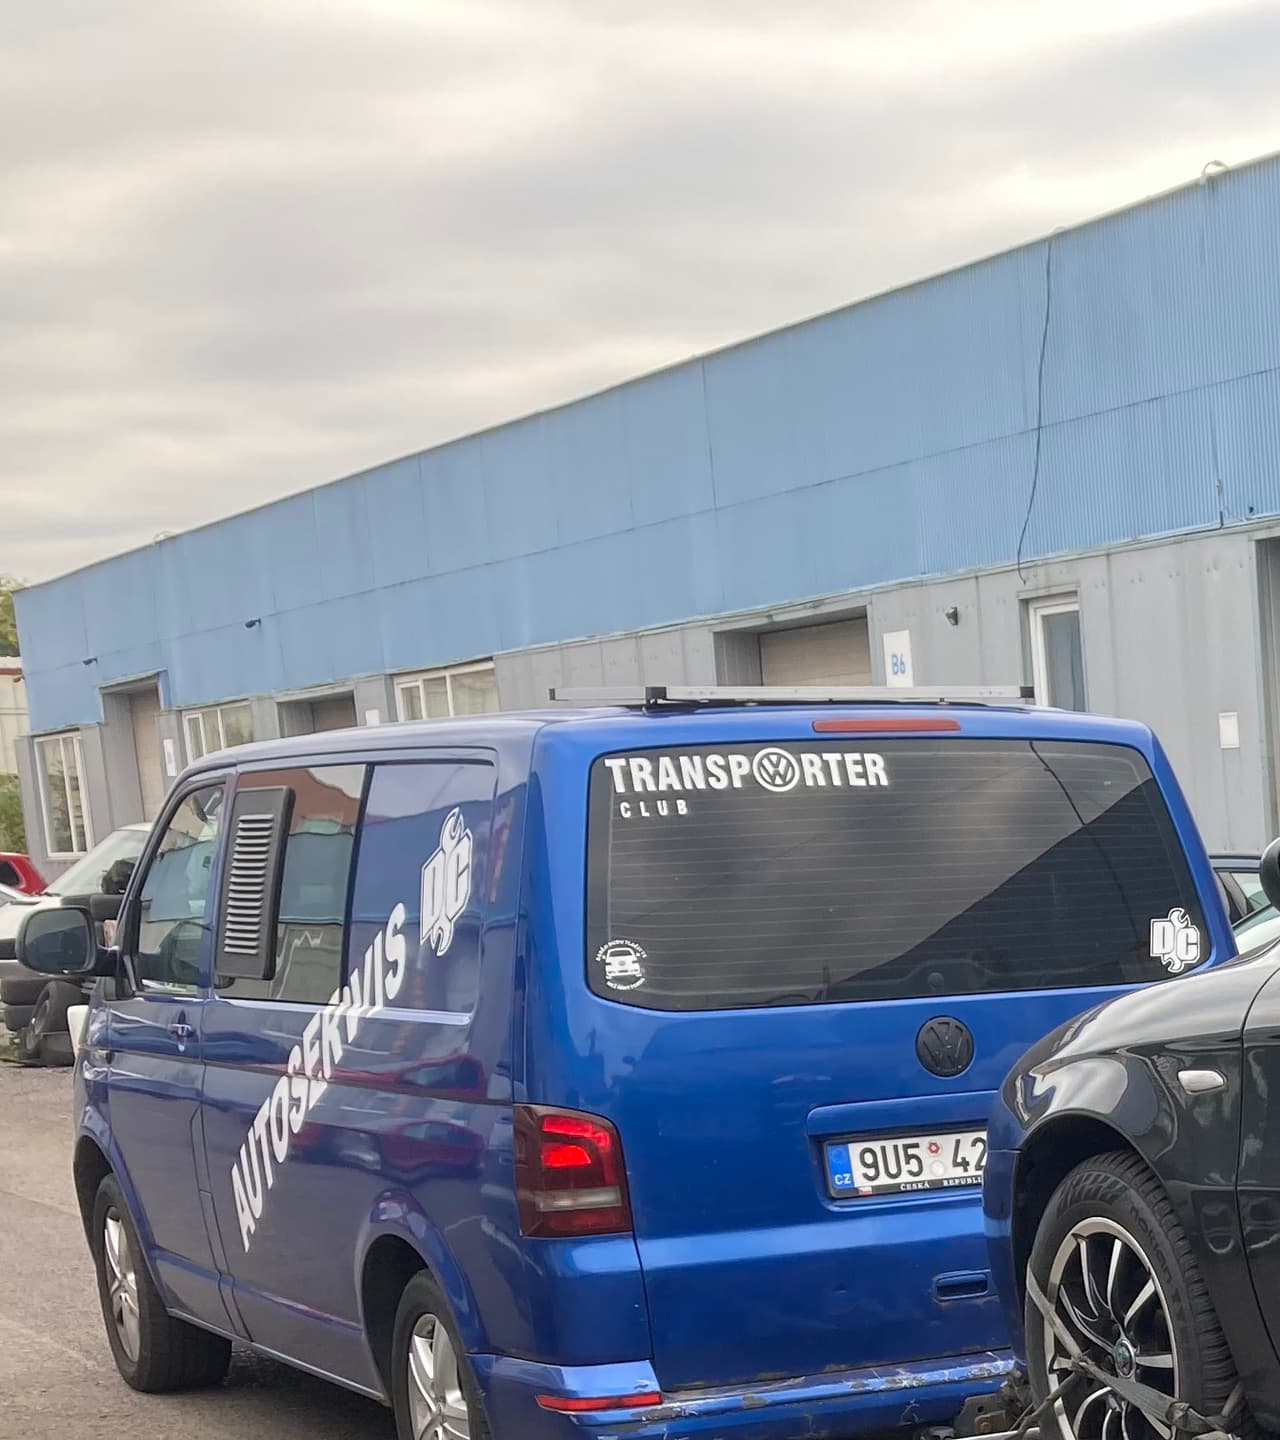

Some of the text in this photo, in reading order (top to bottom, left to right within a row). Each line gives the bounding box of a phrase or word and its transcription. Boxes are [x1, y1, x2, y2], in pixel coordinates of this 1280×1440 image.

[891, 654, 906, 675] B6
[620, 799, 688, 818] CLUB
[1150, 918, 1200, 964] DC
[230, 902, 406, 1254] AUTOSERVIS
[859, 1142, 924, 1182] 9U5
[834, 1174, 852, 1185] CZ
